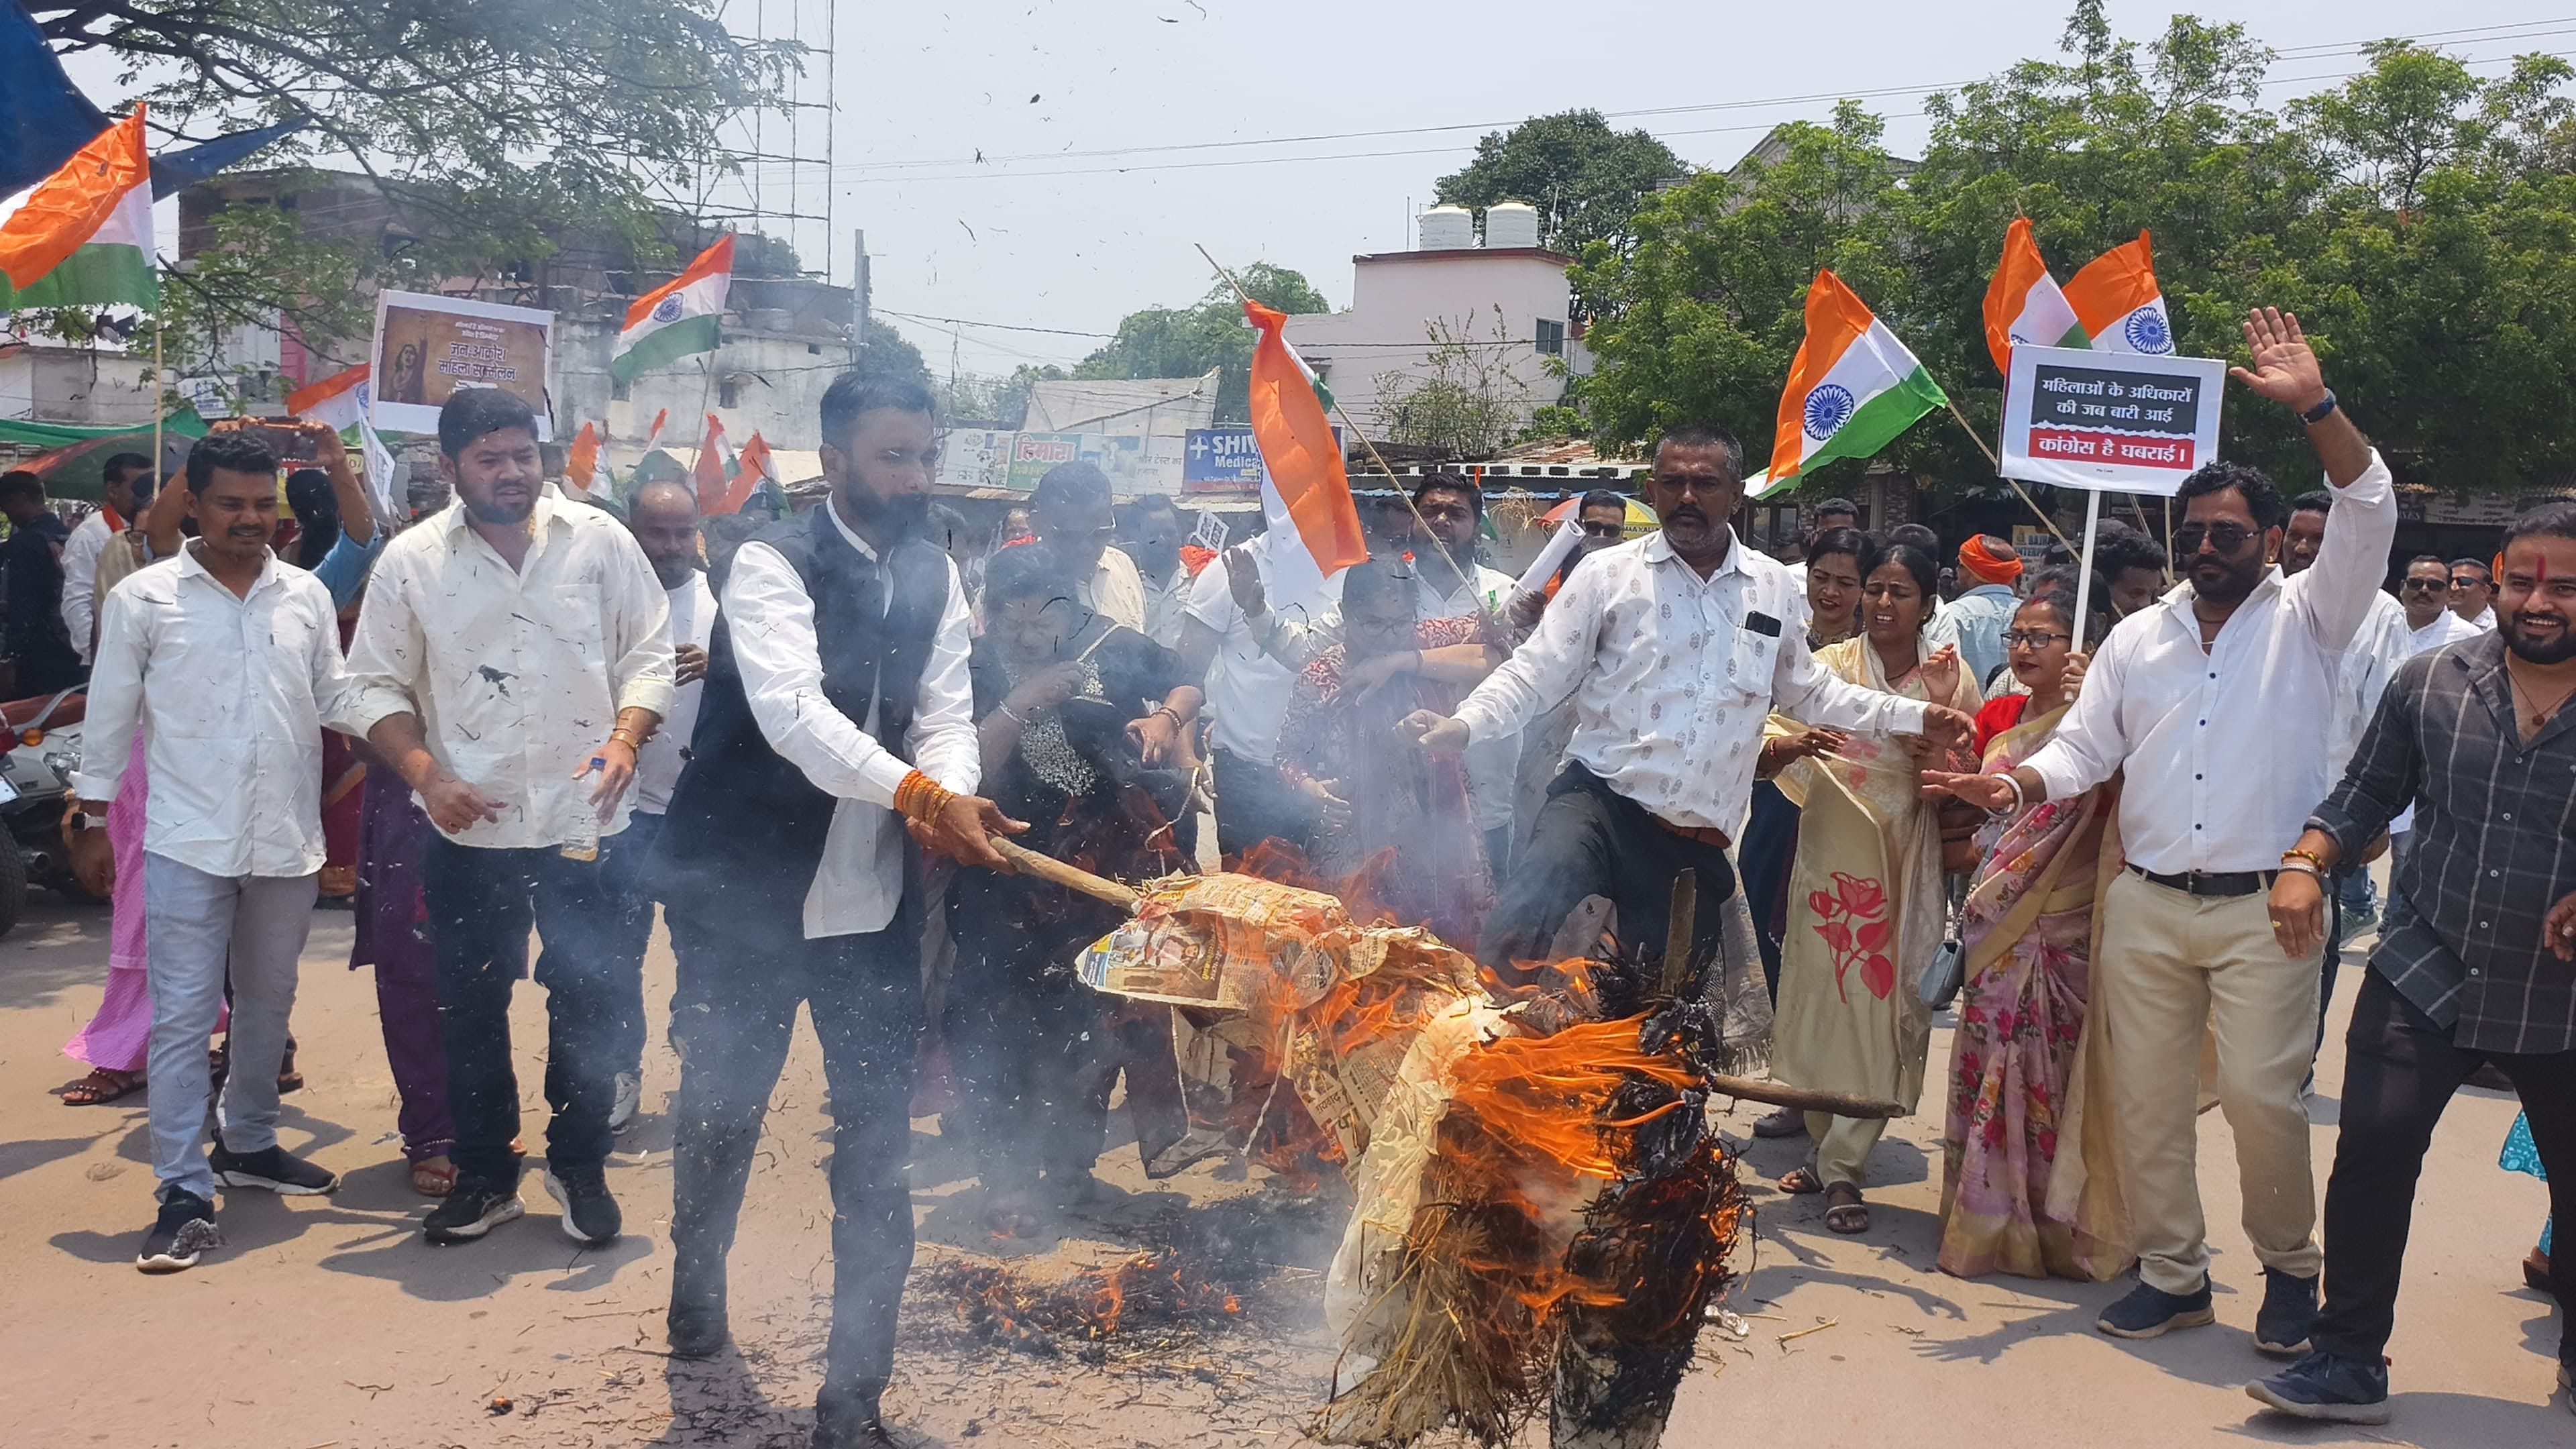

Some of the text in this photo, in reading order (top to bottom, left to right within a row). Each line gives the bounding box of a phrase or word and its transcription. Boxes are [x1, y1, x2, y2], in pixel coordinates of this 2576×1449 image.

[438, 358, 470, 375] महिला
[2042, 377, 2193, 402] महिलाओं के अधिकारों
[2057, 399, 2174, 423] की जब बारी आई
[2039, 435, 2096, 455] कांग्रेस
[2102, 438, 2115, 456] है
